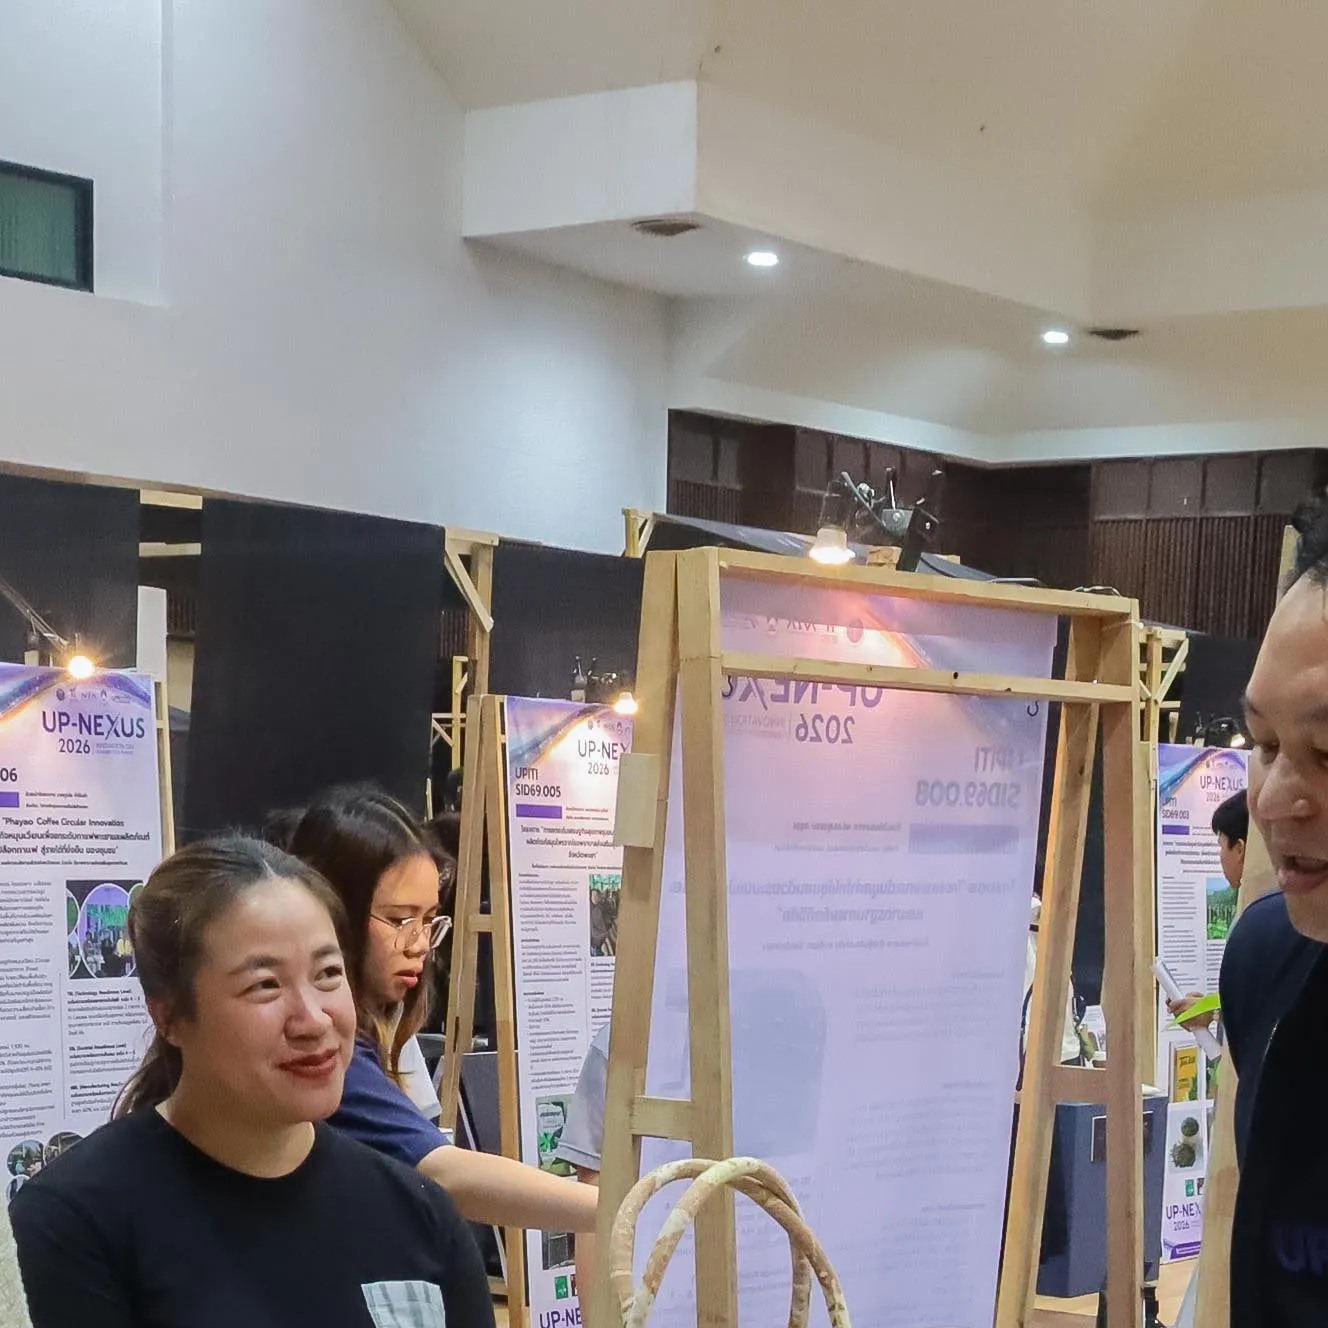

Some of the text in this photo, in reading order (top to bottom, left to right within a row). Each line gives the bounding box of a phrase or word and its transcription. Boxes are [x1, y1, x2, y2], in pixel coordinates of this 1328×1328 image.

[42, 710, 146, 740] UP-NEXUS
[58, 738, 91, 754] 2026
[587, 761, 610, 775] 2026
[515, 783, 561, 798] SID69.005
[36, 818, 59, 826] Coffee
[61, 818, 87, 827] Circular
